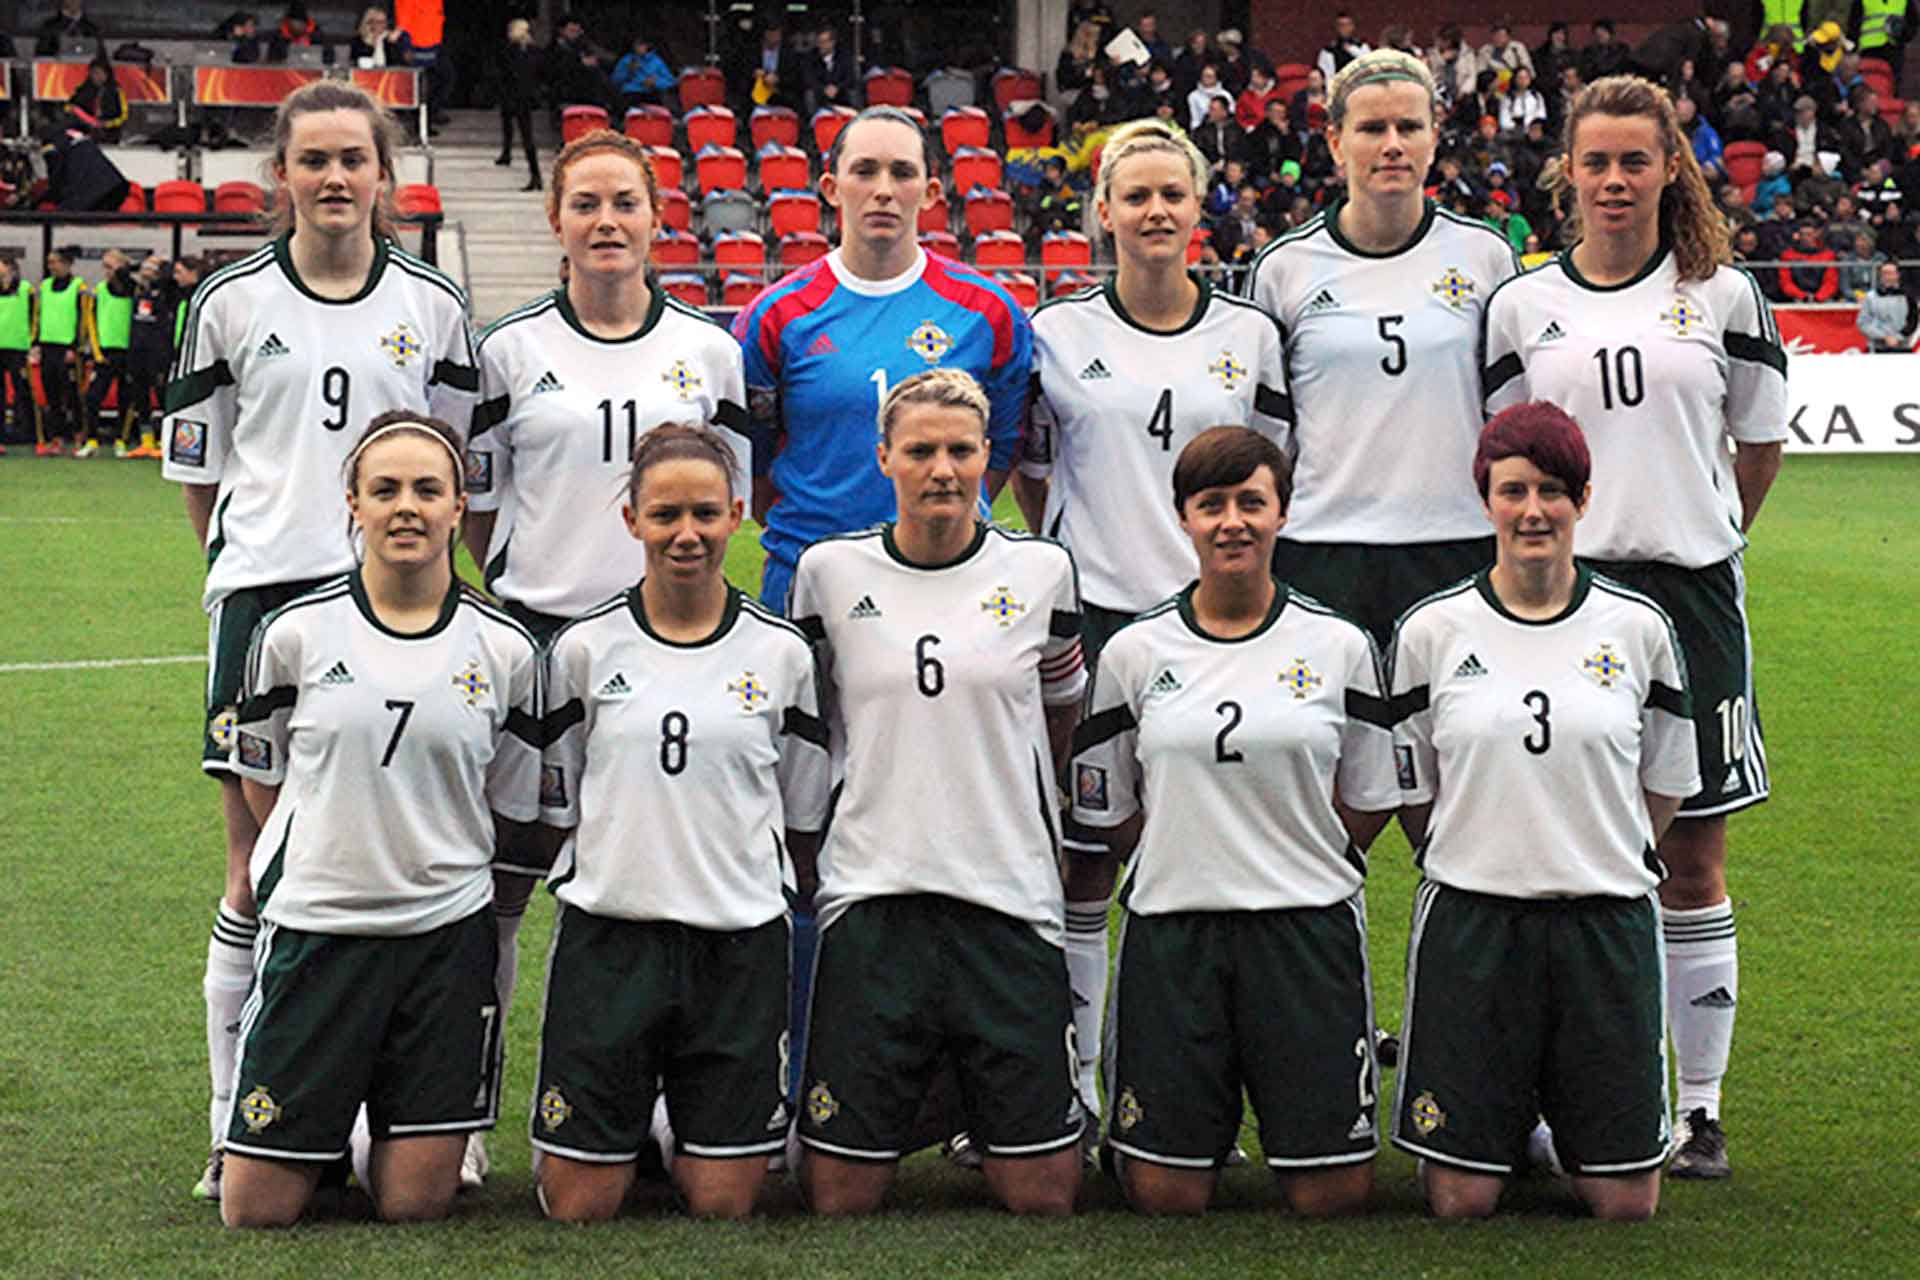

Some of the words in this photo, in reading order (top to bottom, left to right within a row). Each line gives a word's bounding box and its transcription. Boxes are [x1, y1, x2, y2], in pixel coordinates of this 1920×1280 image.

[1379, 315, 1406, 376] 5
[322, 367, 350, 431] 9
[870, 368, 888, 413] 1
[1594, 346, 1644, 410] 10
[597, 399, 637, 463] 11
[1147, 389, 1174, 451] 4
[916, 634, 945, 698] 6
[380, 699, 415, 767] 7
[660, 711, 688, 776] 8
[1216, 701, 1244, 763] 2
[1523, 690, 1551, 755] 3
[1716, 696, 1745, 764] 10
[481, 1005, 497, 1076] 7
[1355, 1037, 1375, 1106] 2
